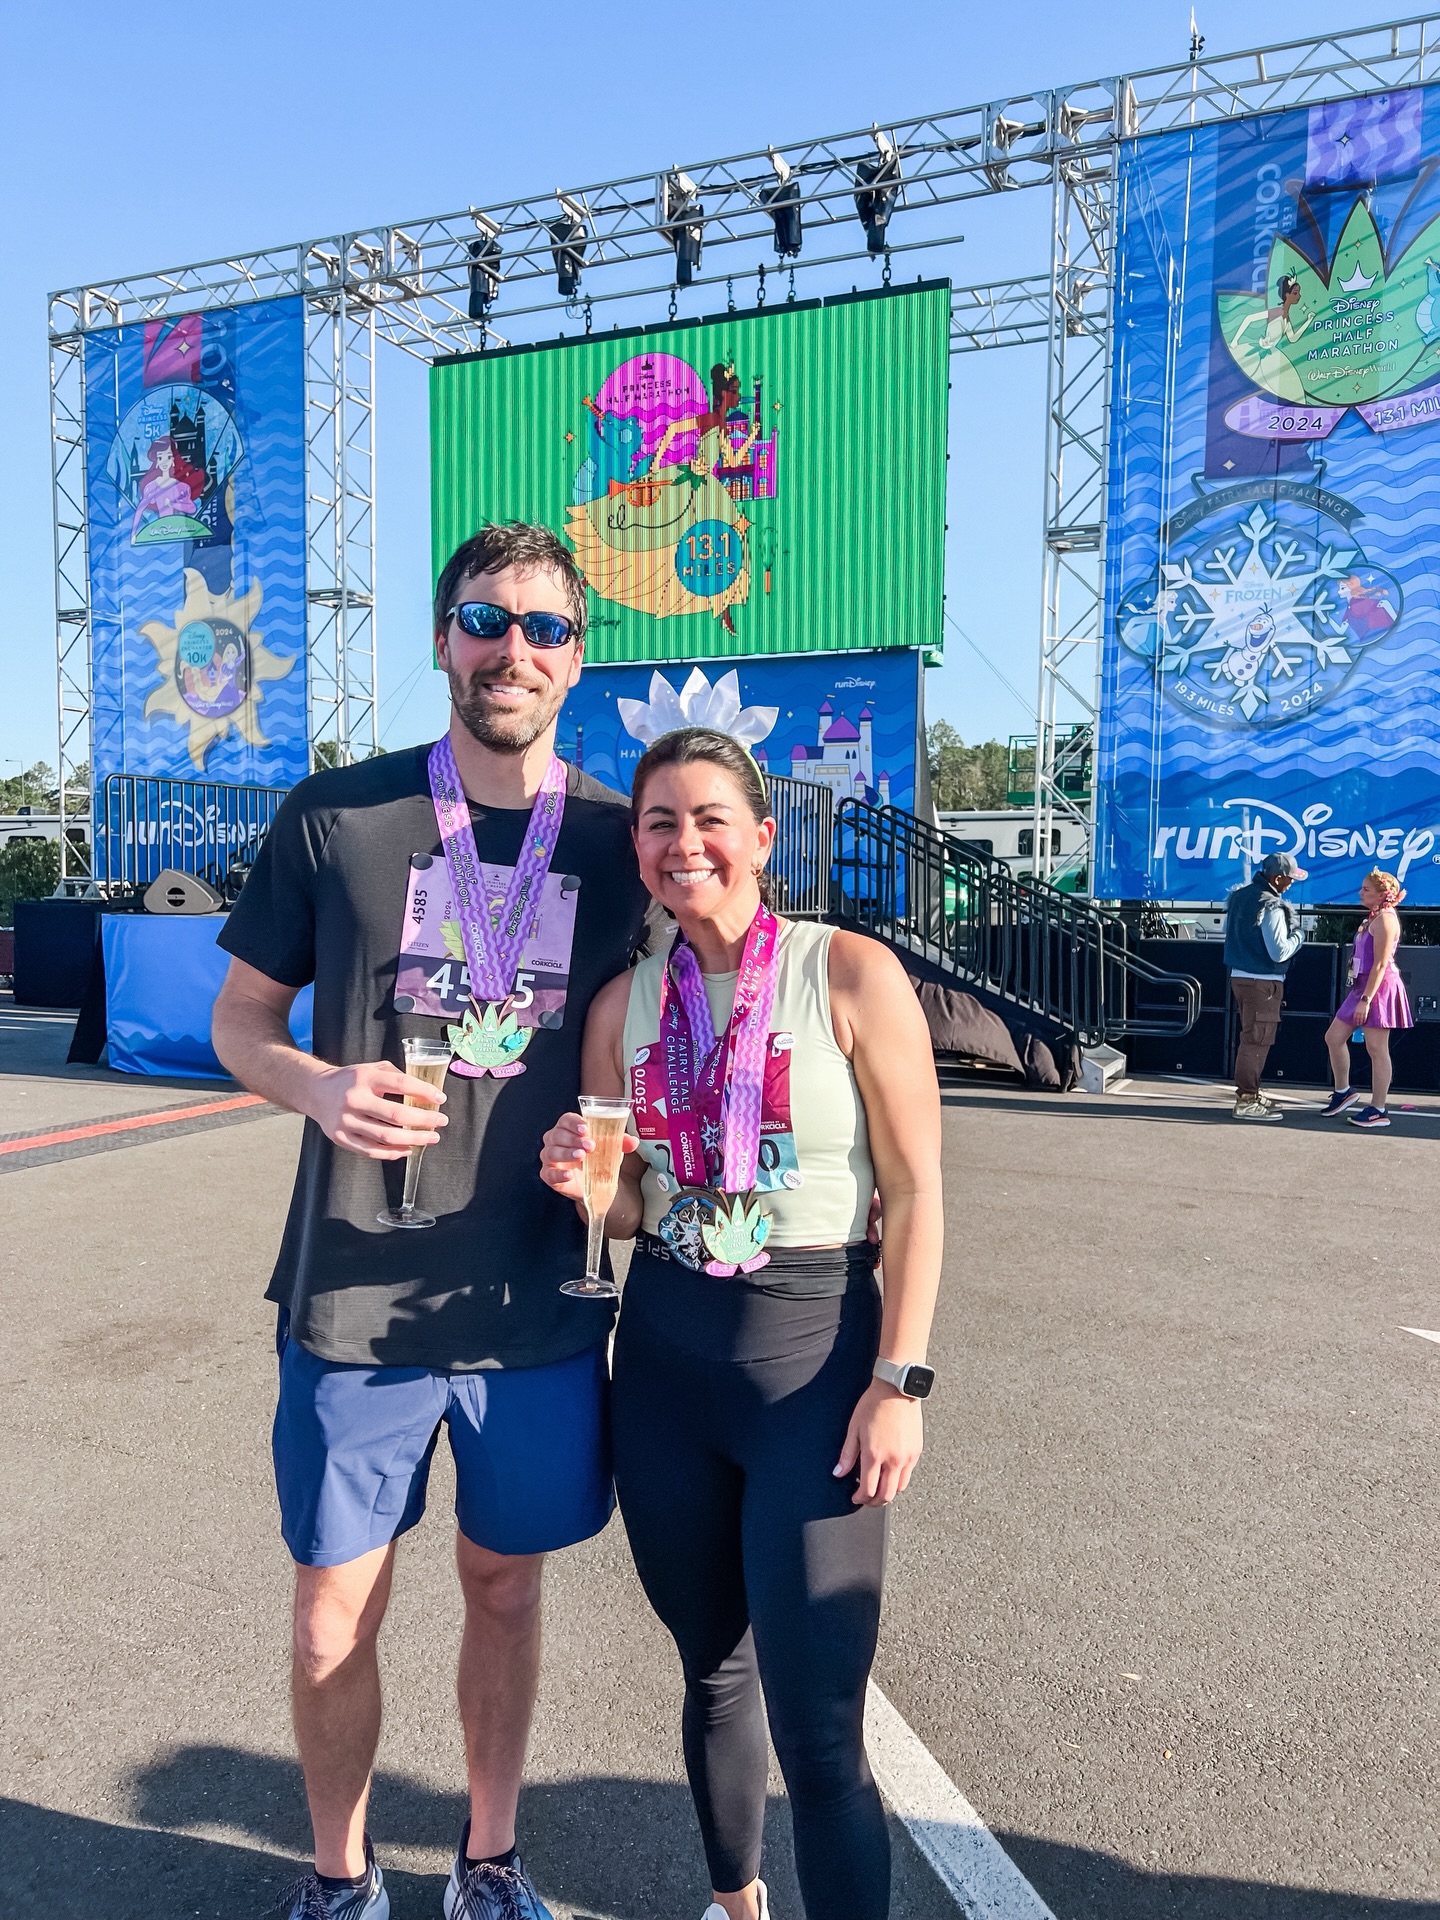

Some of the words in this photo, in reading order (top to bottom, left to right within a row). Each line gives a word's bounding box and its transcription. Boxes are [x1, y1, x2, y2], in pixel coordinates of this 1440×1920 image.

[1251, 163, 1281, 293] CORKCICL
[1329, 296, 1380, 314] Disney
[1313, 311, 1395, 332] PRINCESS
[1333, 328, 1373, 343] HALF
[1307, 339, 1399, 361] MARATHON
[1267, 415, 1324, 432] 2024
[1374, 405, 1406, 426] 13.1
[1410, 395, 1440, 418] MIL
[144, 423, 161, 438] 5K
[1246, 483, 1276, 496] TALE
[1278, 483, 1350, 518] CHALLENGE
[685, 533, 731, 561] 13.1
[682, 561, 736, 578] MILES
[1225, 587, 1282, 604] FROZEN
[215, 628, 234, 636] 2024
[187, 651, 207, 664] 10K
[834, 676, 876, 690] runDisney
[1173, 680, 1196, 702] 19.3
[1196, 696, 1235, 716] MILES
[1280, 682, 1323, 712] 2024
[619, 748, 643, 759] HAL
[435, 773, 453, 828] PRINCESS
[447, 836, 471, 907] MARATHON
[462, 853, 478, 886] HALF
[412, 889, 428, 925] 4585
[443, 900, 452, 920] 2024
[425, 963, 536, 1009] 455
[747, 964, 763, 999] FAIRY
[677, 1036, 689, 1075] FAIRY
[666, 1035, 681, 1115] CHALLENGE
[634, 1068, 648, 1114] 25070
[680, 1079, 691, 1112] TALE
